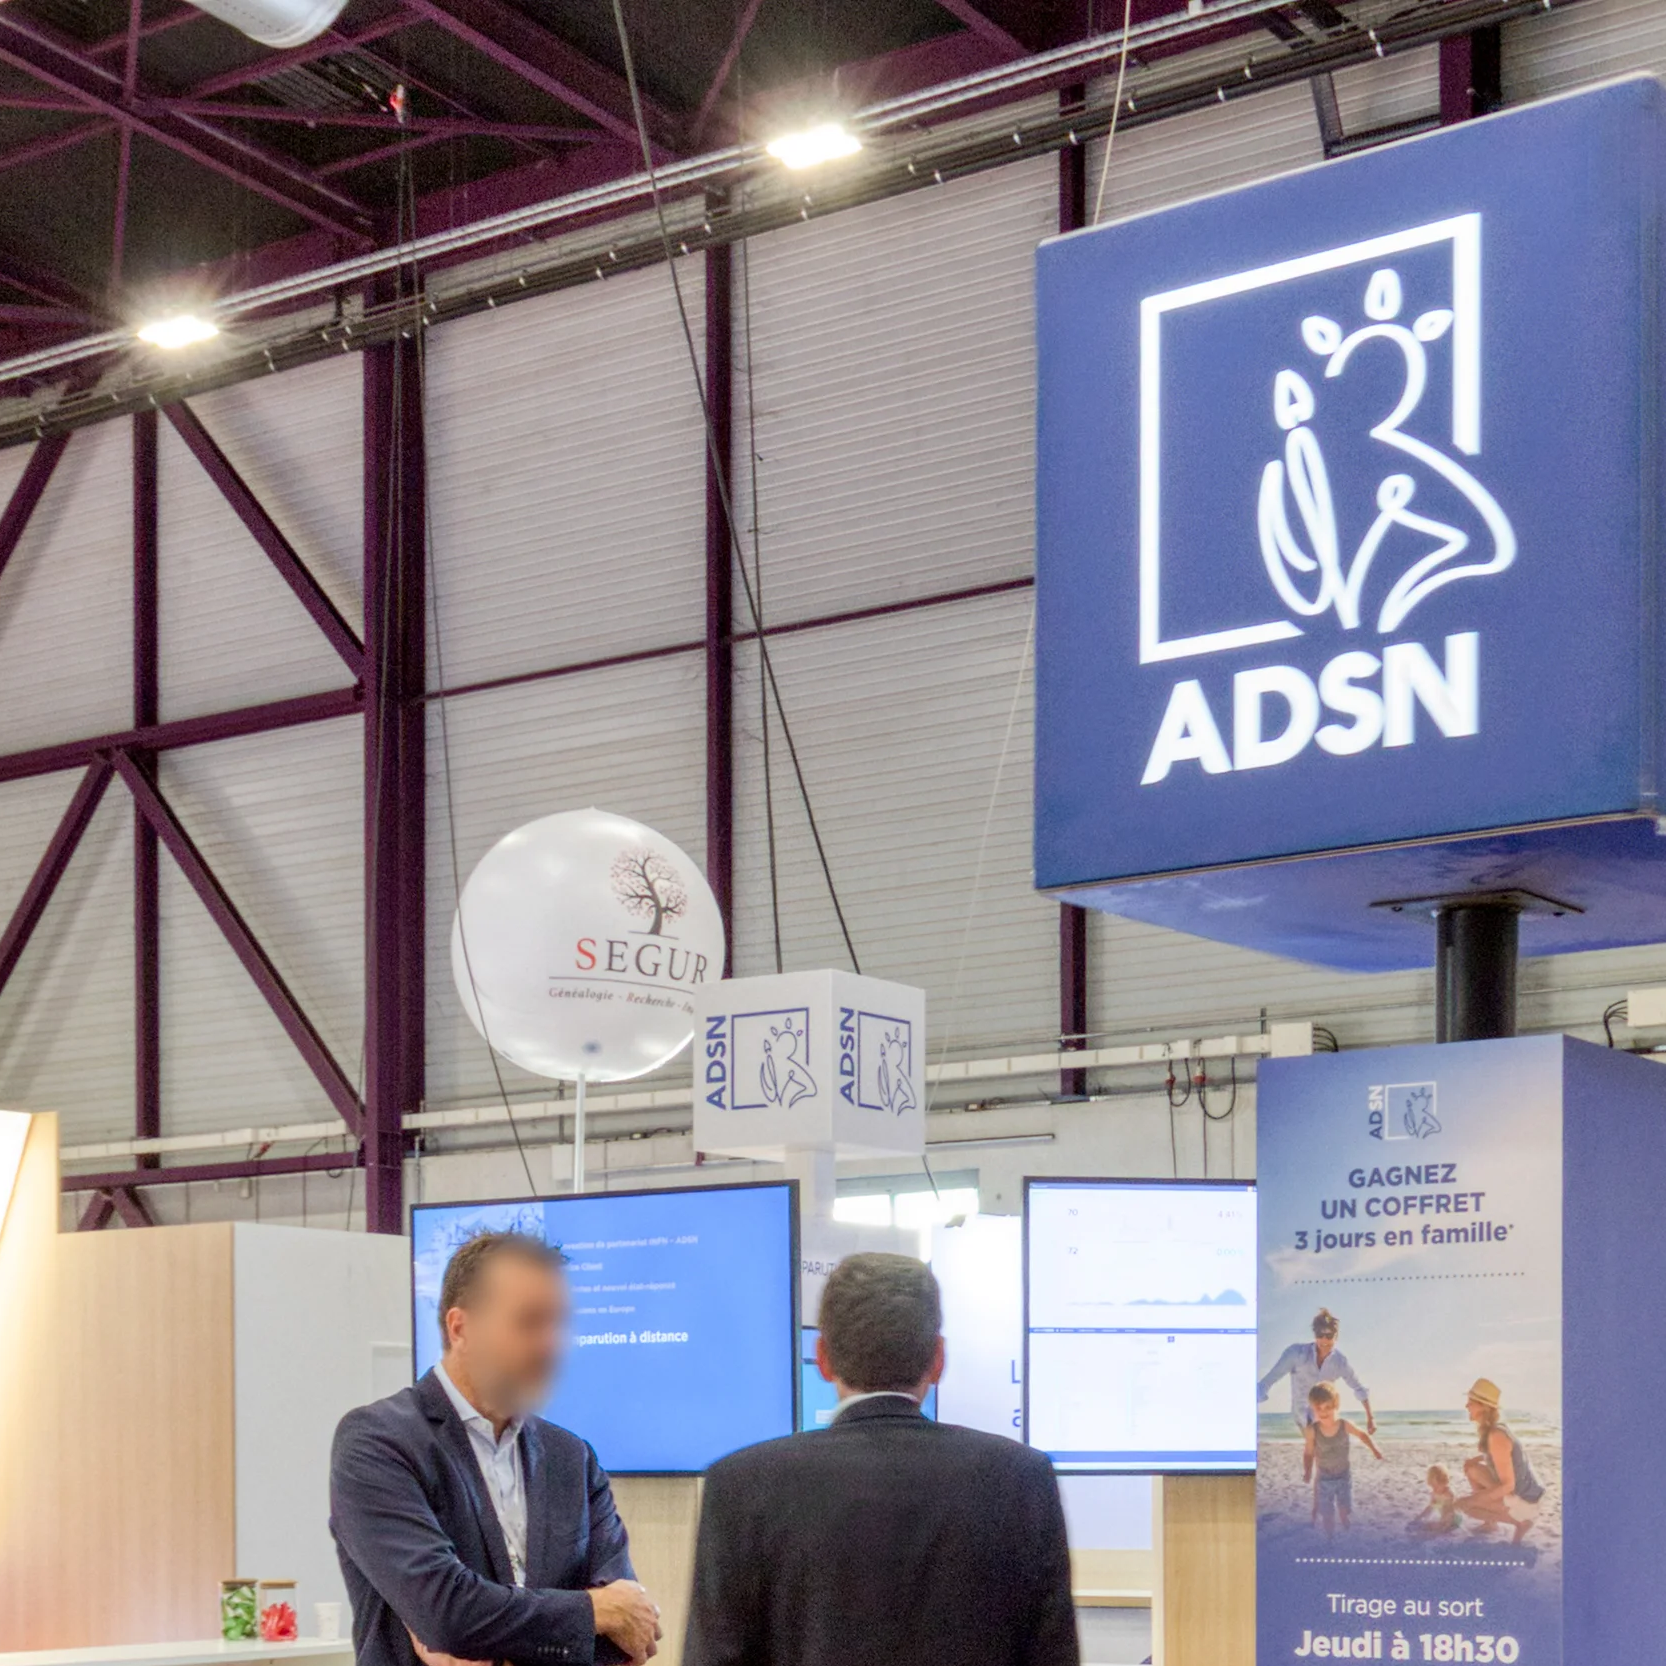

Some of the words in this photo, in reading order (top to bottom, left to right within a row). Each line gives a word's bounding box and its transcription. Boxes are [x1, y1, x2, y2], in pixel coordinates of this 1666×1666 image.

[1140, 631, 1482, 786] ADSN
[575, 937, 708, 985] SEGUR
[548, 986, 614, 1001] Généalogie
[705, 1014, 727, 1111] ADSN
[839, 1006, 856, 1105] ADSN
[1368, 1084, 1384, 1140] ADSN
[1348, 1162, 1457, 1189] GAGNEZ
[1320, 1198, 1357, 1220] UN
[1365, 1191, 1486, 1218] COFFRET
[1294, 1230, 1309, 1250] 3
[1314, 1228, 1376, 1253] jours
[1383, 1227, 1413, 1247] en
[575, 1331, 627, 1347] parution
[630, 1331, 637, 1344] à
[639, 1330, 689, 1344] distance
[1326, 1593, 1397, 1618] Tirage
[1403, 1599, 1431, 1616] au
[1438, 1597, 1484, 1617] sort
[1294, 1630, 1382, 1659] Jeudi
[1391, 1630, 1410, 1660] à
[1419, 1633, 1520, 1664] 18h30
